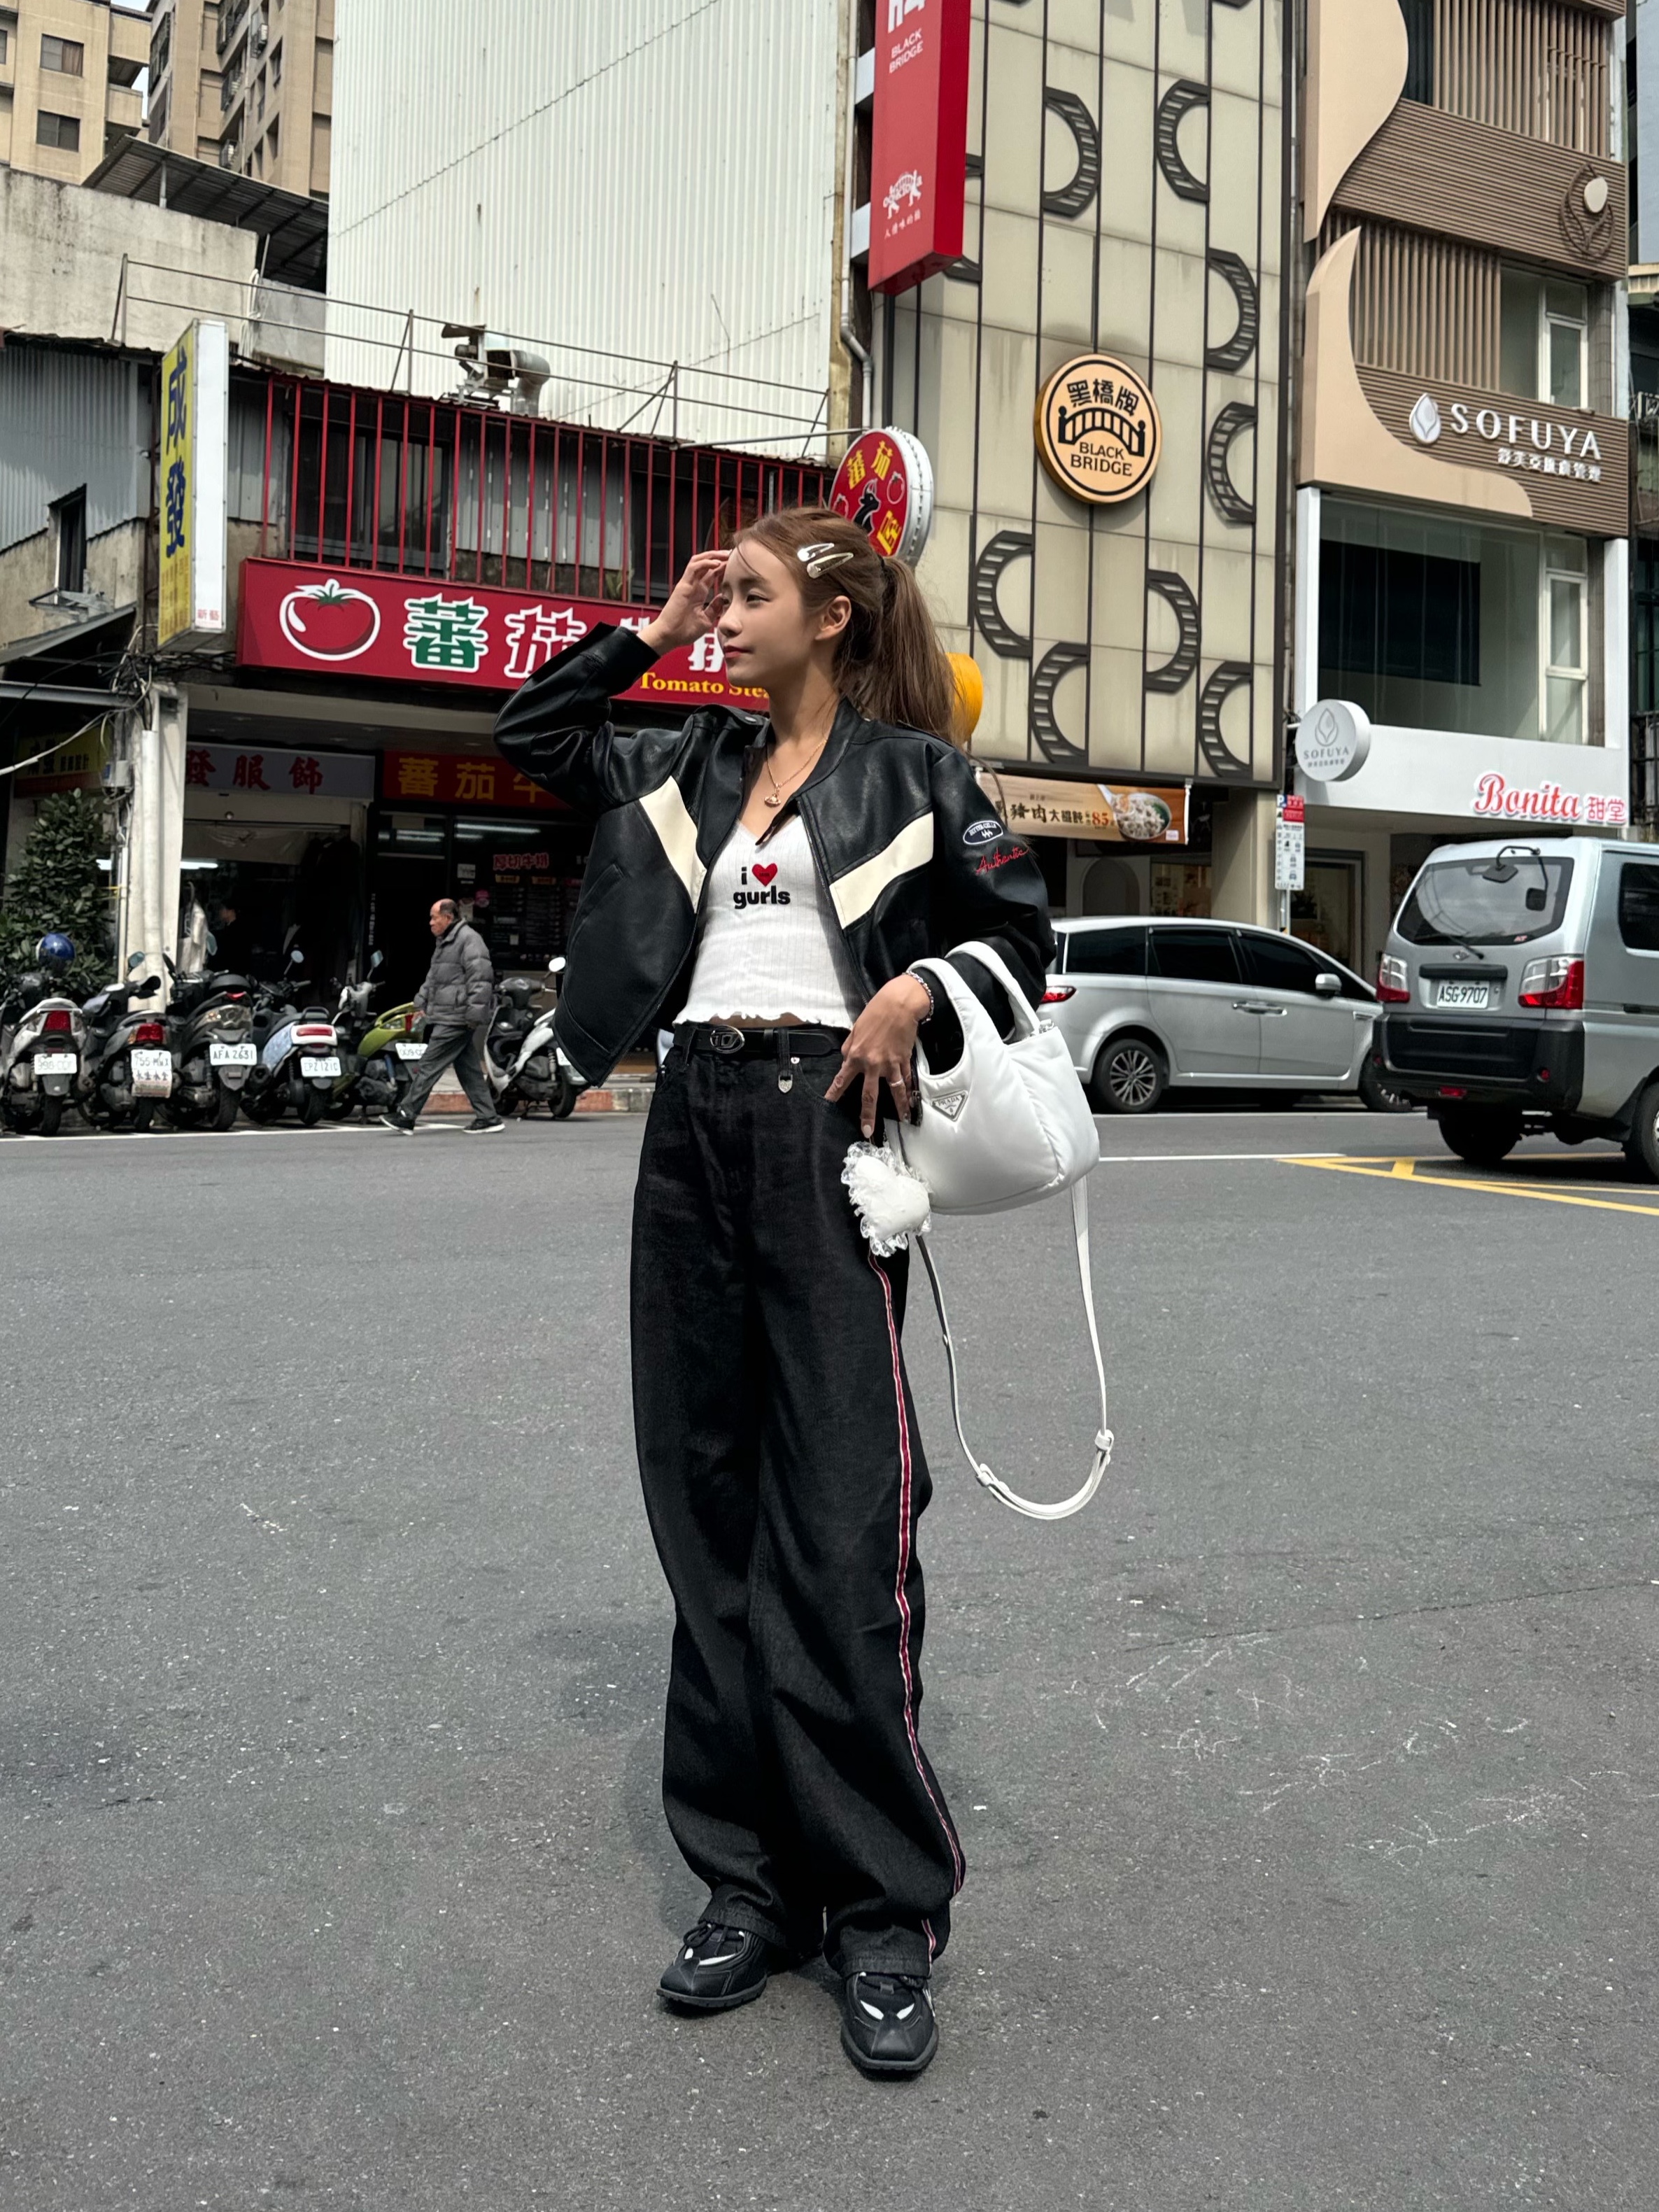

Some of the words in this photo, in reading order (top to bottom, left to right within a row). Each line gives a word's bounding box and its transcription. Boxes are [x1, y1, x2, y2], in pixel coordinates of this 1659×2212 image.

[891, 28, 922, 59] BLACK
[889, 41, 924, 73] BRIDGE
[1066, 379, 1139, 416] 黑橋牌
[1450, 402, 1602, 460] SOFUYA
[1080, 442, 1125, 460] BLACK
[1071, 453, 1133, 477] BRIDGE
[640, 672, 724, 694] Tomato
[1303, 745, 1349, 760] SOFUYA
[1474, 773, 1581, 819] Bonita
[1588, 796, 1626, 822] 甜堂
[1092, 811, 1110, 826] 85
[975, 845, 1029, 875] Authentic
[741, 866, 747, 885] i
[733, 885, 791, 910] gurls
